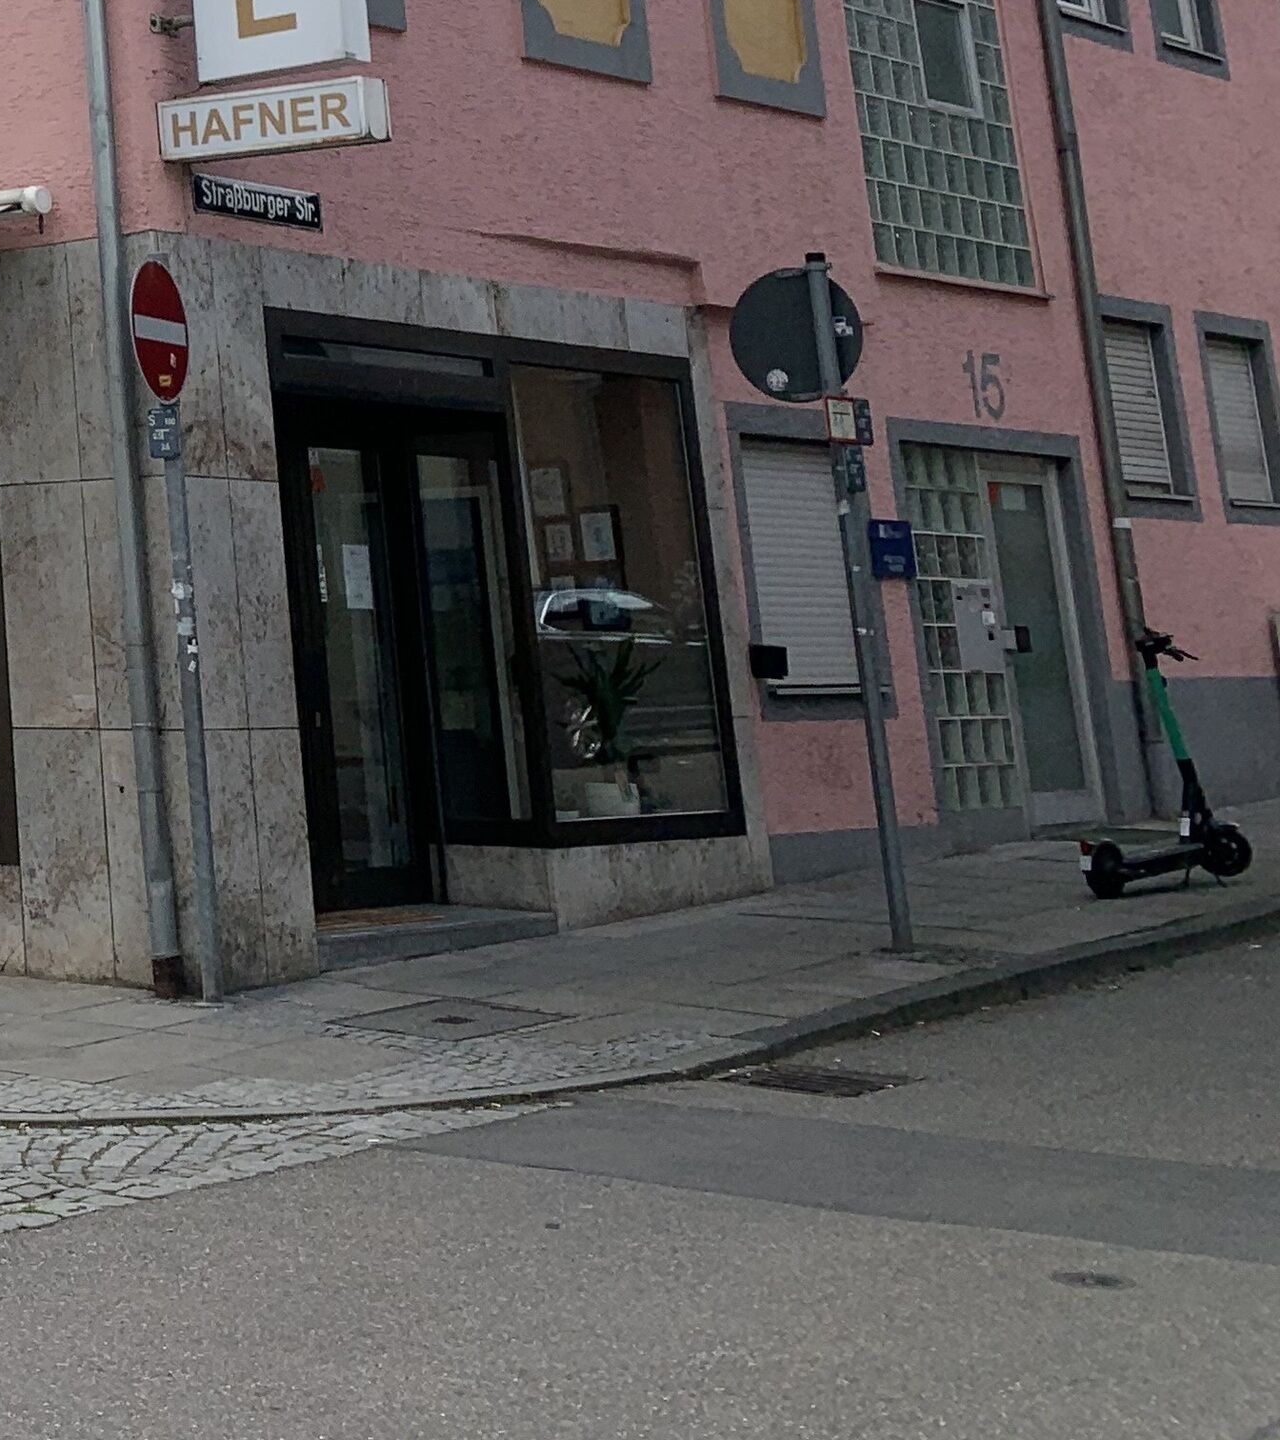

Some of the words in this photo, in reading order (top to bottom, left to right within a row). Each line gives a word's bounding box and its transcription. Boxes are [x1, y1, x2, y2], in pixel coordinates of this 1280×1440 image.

[171, 92, 352, 148] HAFNER
[200, 178, 291, 220] Straßburger
[294, 196, 319, 223] Str.
[961, 349, 1005, 421] 15
